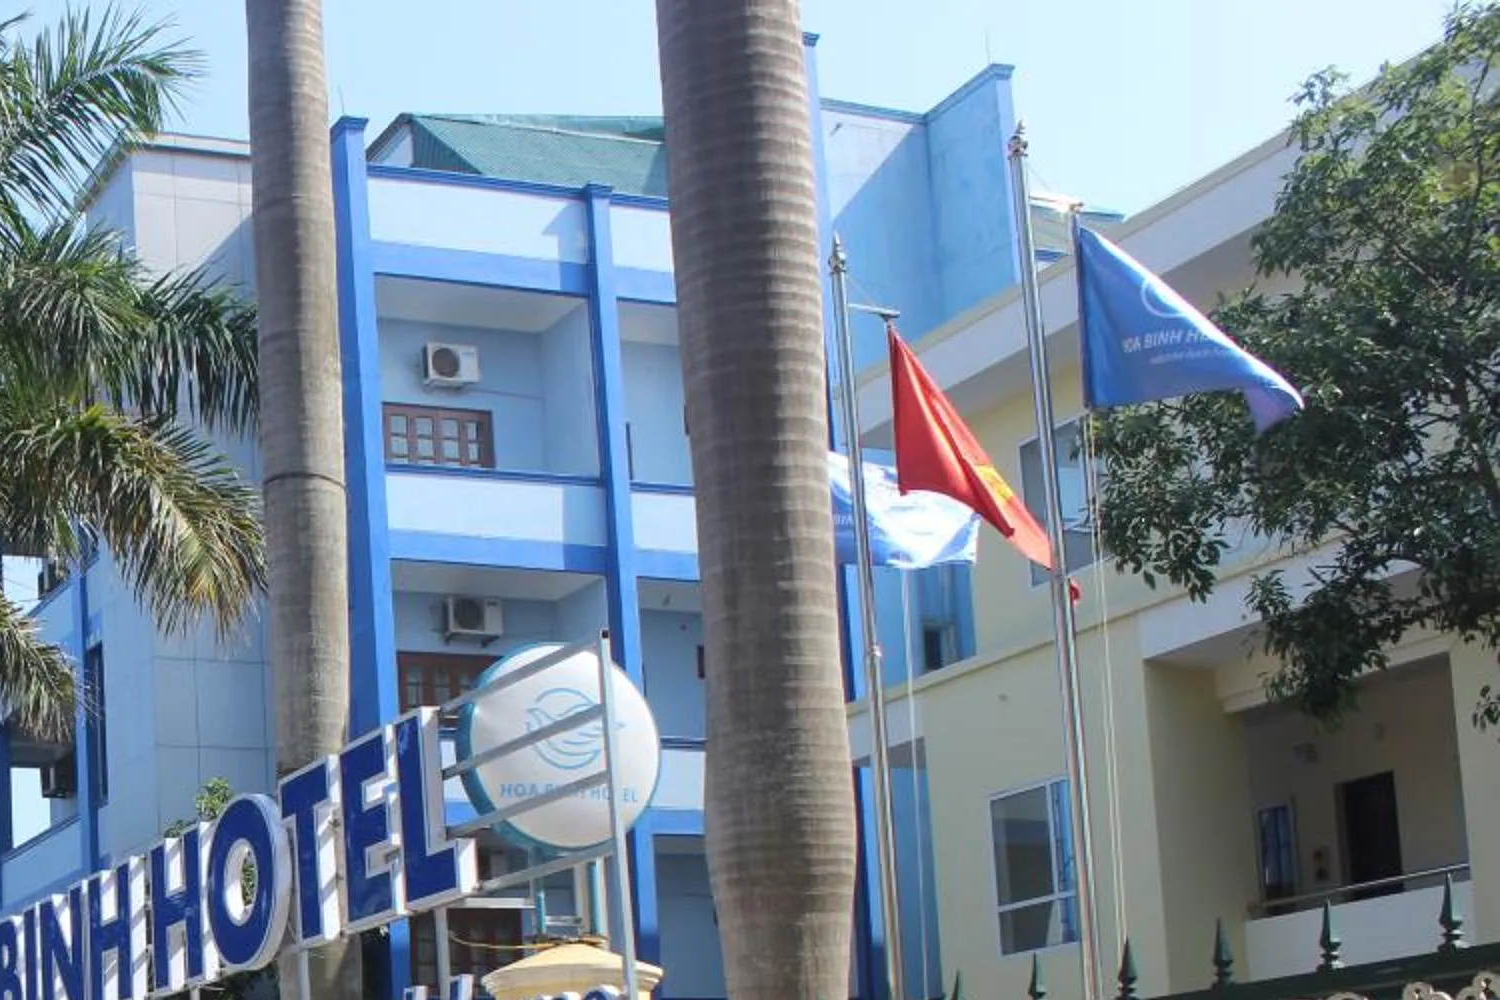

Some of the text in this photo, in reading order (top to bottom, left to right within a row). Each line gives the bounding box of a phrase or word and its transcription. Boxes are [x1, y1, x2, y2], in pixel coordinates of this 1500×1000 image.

[149, 706, 478, 998] HOTEL
[500, 783, 539, 798] HOA
[590, 786, 638, 803] HOEL
